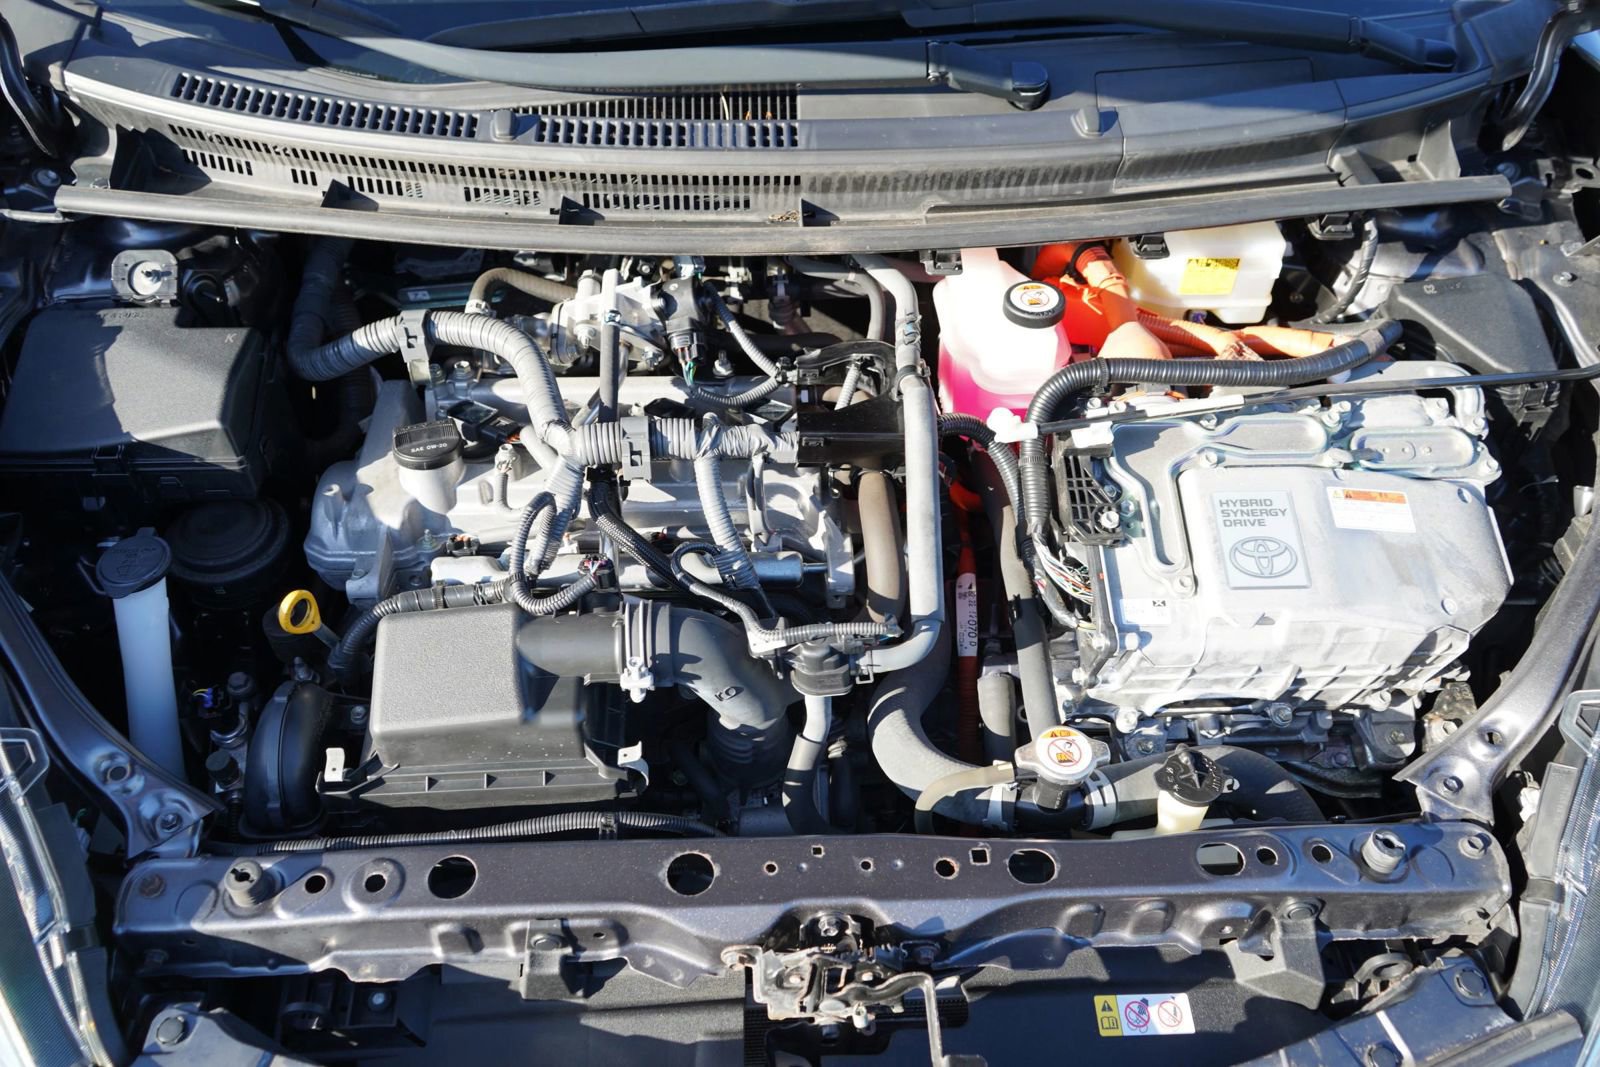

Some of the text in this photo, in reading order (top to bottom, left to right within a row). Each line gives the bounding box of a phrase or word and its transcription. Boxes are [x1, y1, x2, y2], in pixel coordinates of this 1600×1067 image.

[1219, 498, 1273, 507] HYBRID
[1221, 508, 1287, 517] SYNERGY
[1223, 518, 1267, 527] DRIVE
